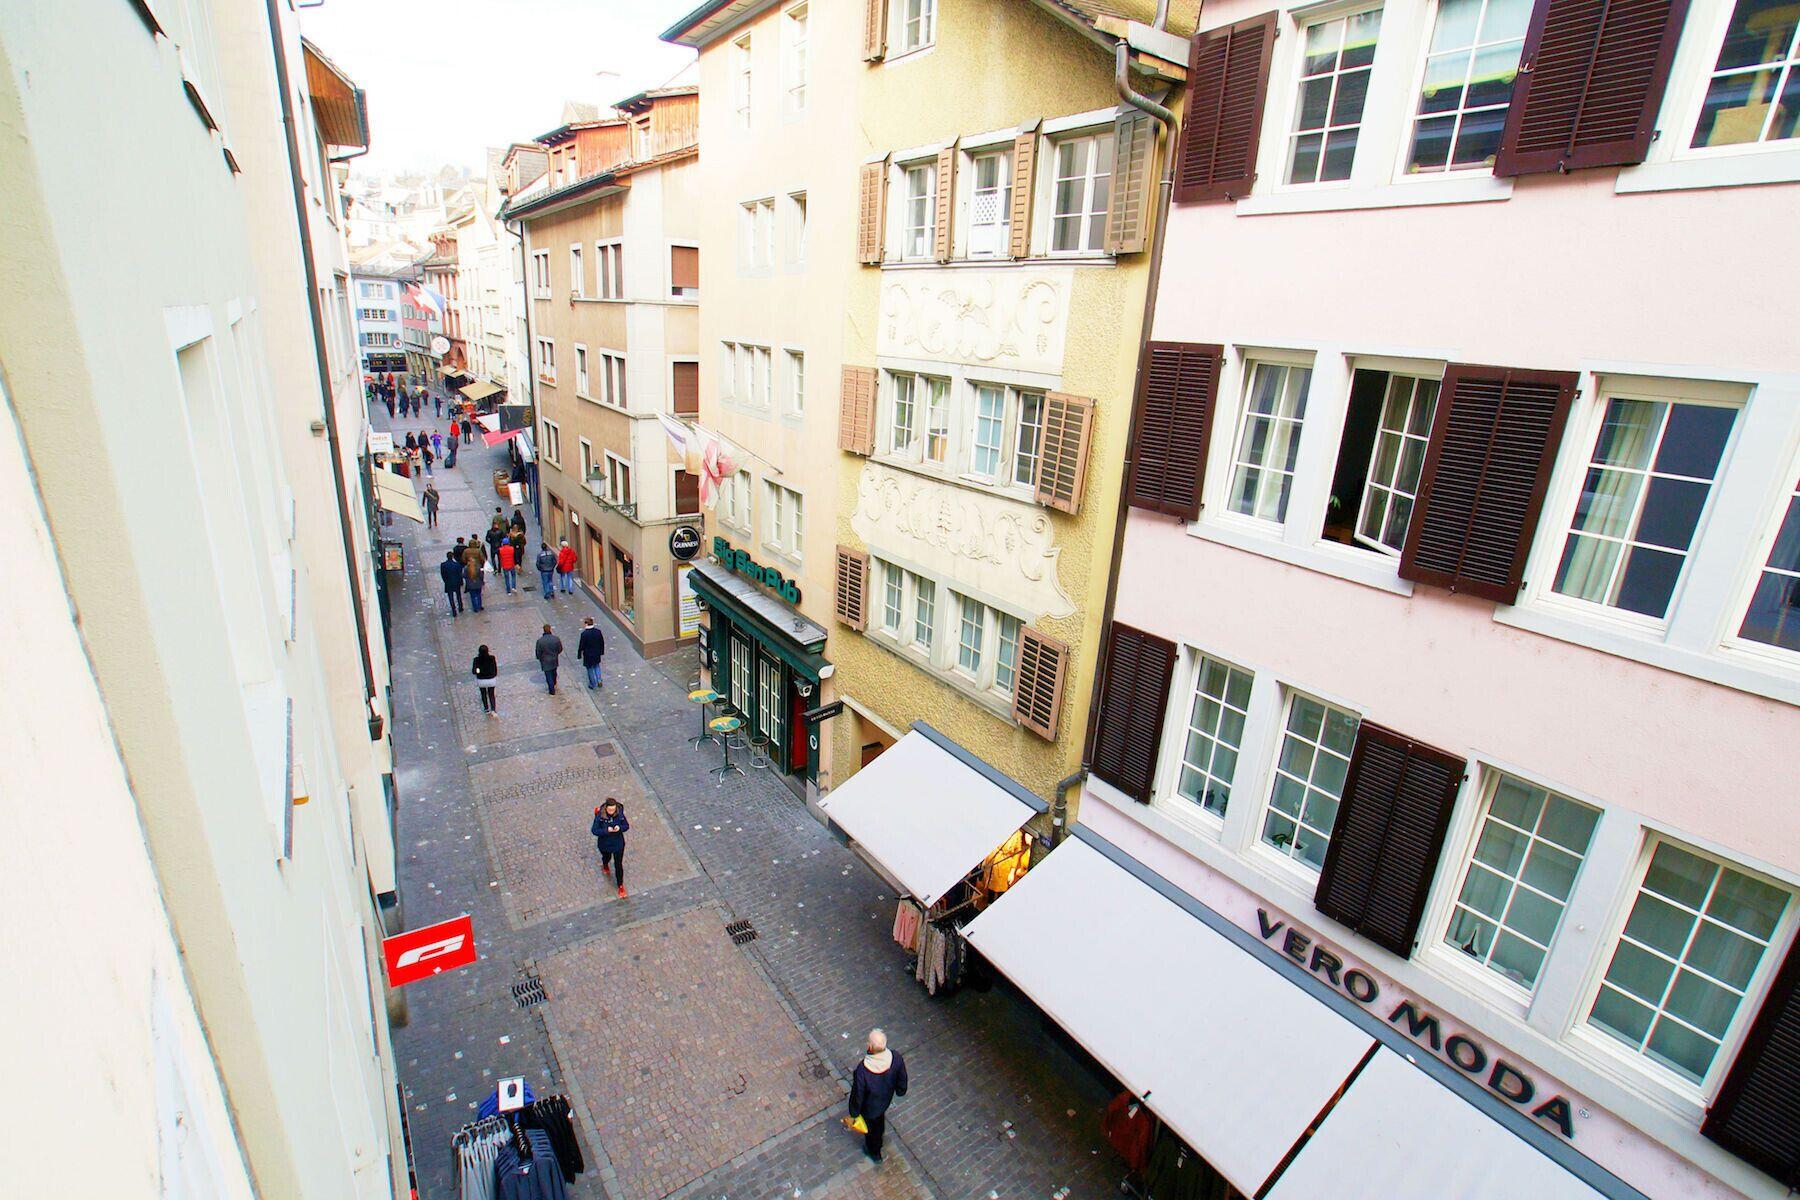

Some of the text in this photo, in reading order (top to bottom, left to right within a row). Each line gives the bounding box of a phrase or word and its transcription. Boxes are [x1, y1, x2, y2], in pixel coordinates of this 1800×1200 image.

[674, 541, 698, 549] GUINNESS
[713, 536, 802, 605] Big Ben Pub
[1257, 907, 1575, 1139] VERO MODA
